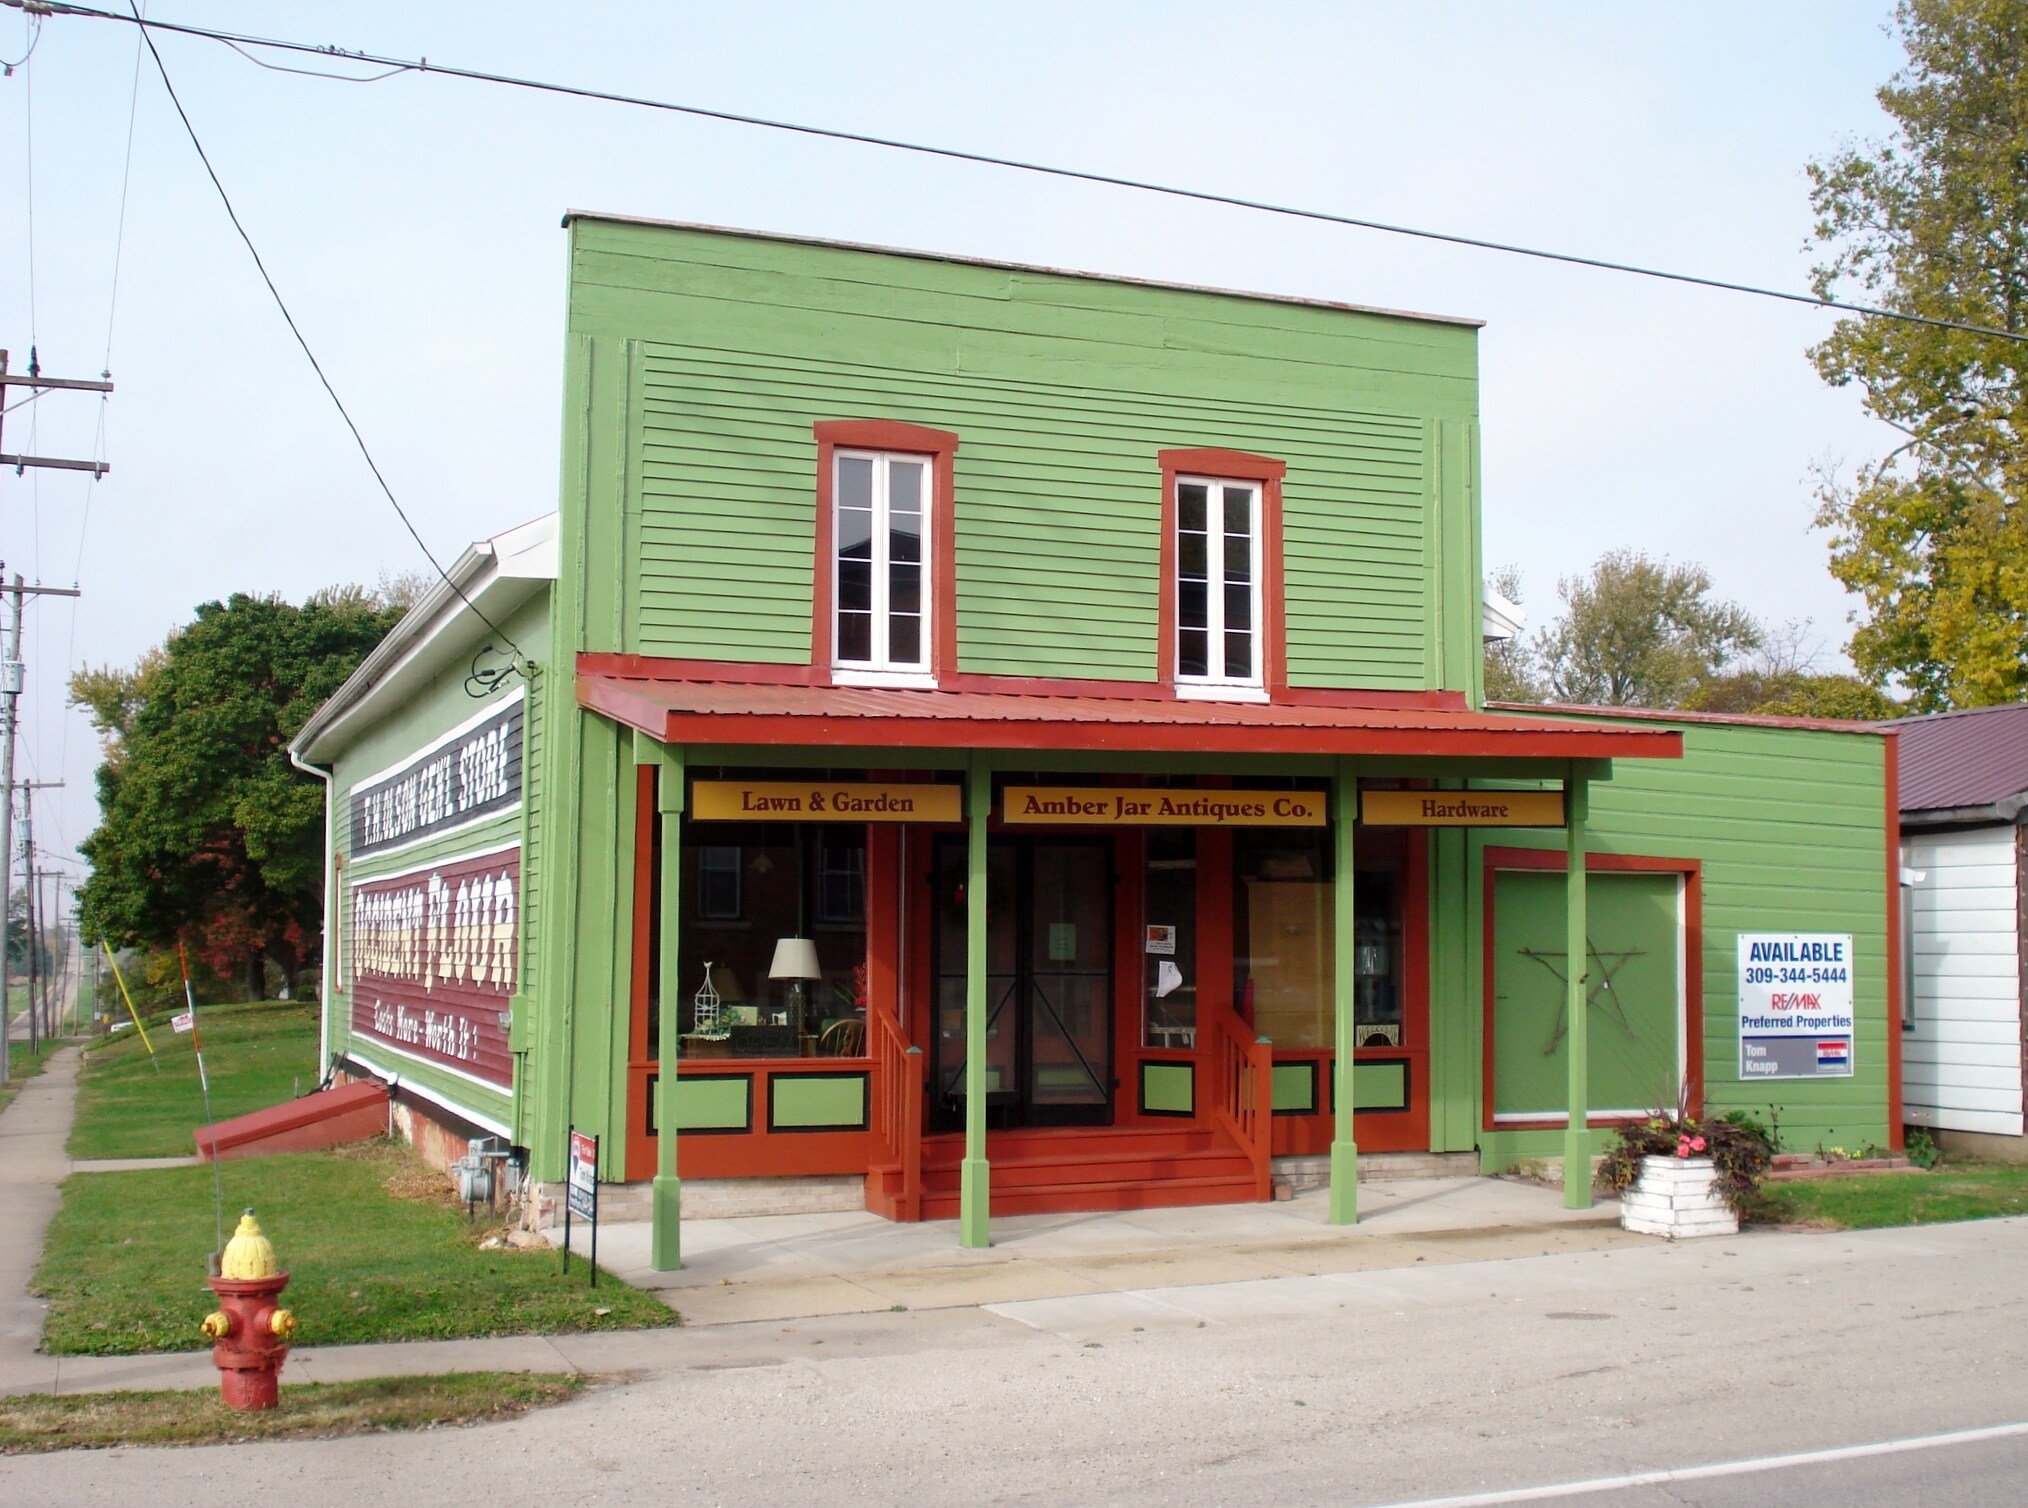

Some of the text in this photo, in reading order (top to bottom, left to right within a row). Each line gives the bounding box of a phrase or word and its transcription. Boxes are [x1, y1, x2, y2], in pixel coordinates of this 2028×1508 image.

[457, 722, 509, 812] STORE
[742, 791, 914, 812] Lawn & Garden
[1022, 795, 1313, 822] Amber Jar Antiques Co.
[1421, 799, 1509, 818] Hardware
[355, 870, 515, 995] OCCIDENT FLOUR
[1750, 942, 1843, 962] AVAILABLE
[1746, 967, 1847, 984] 309-344-5444
[1771, 992, 1822, 1011] RE/MAX
[1741, 1015, 1852, 1030] Preferred Properties
[1745, 1044, 1767, 1057] Tom
[1745, 1060, 1779, 1074] Knapp
